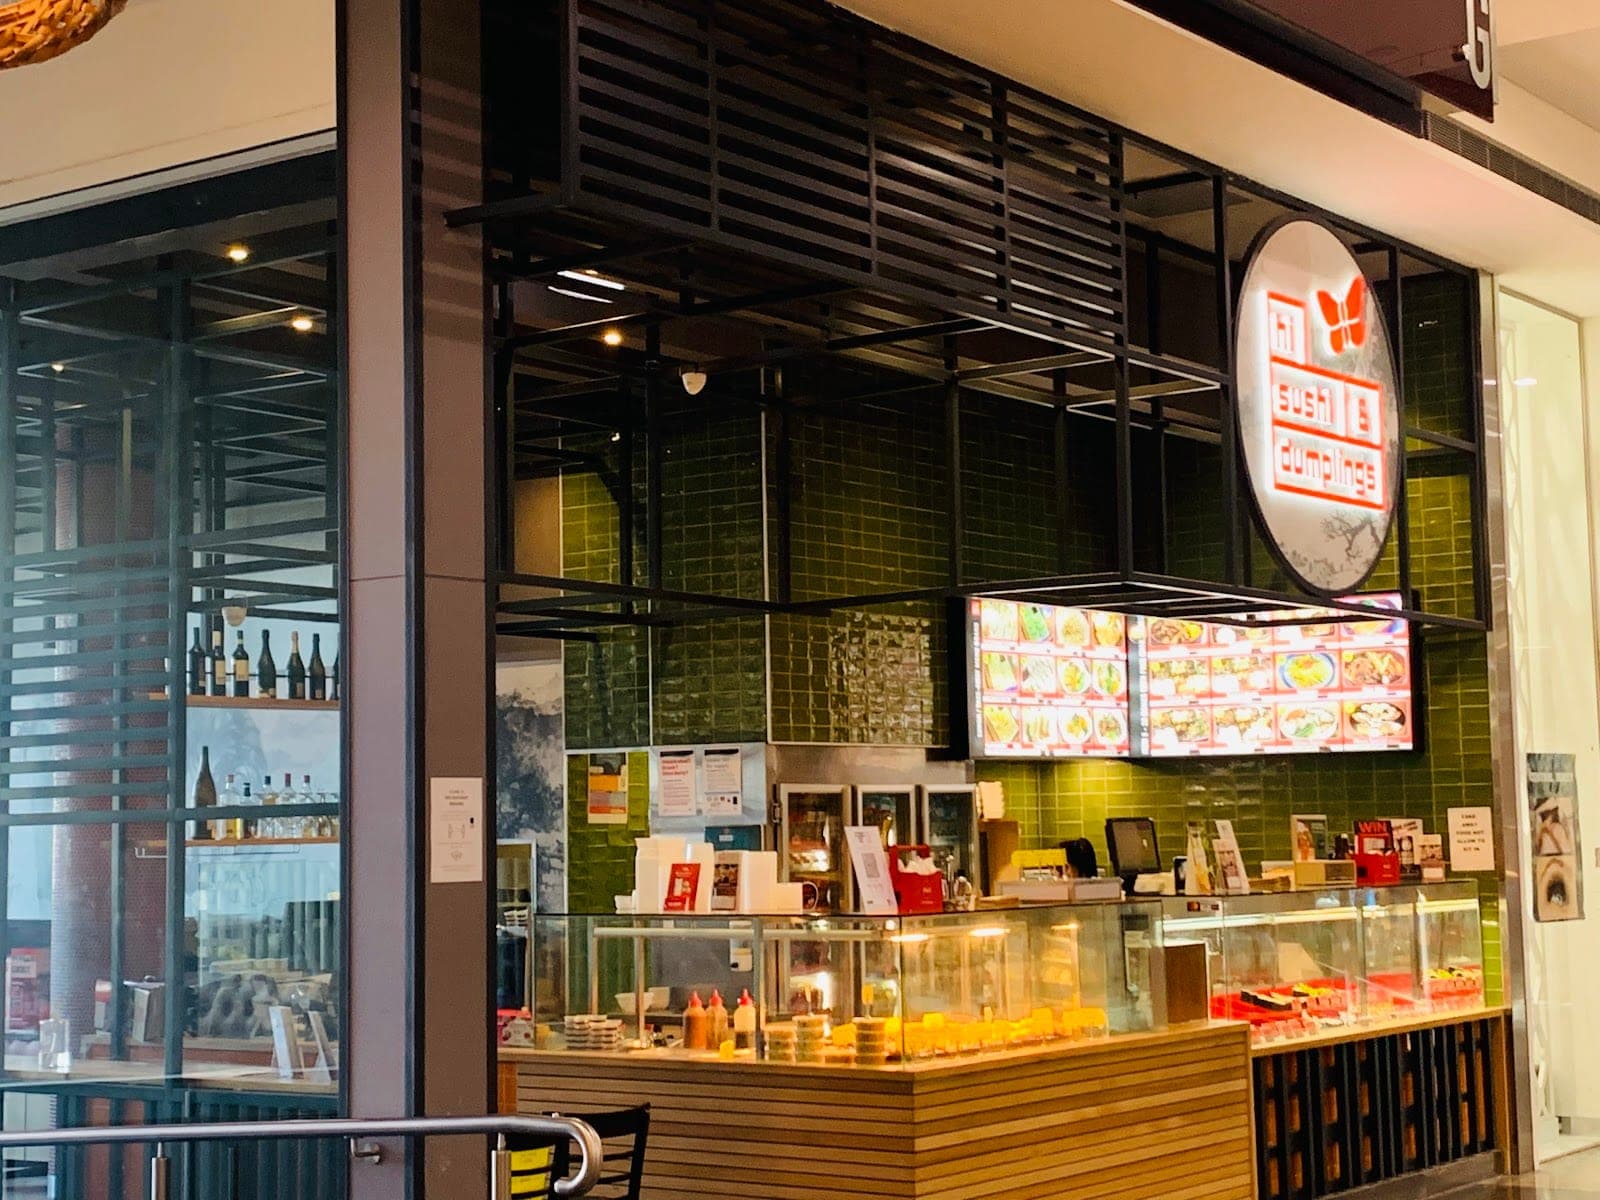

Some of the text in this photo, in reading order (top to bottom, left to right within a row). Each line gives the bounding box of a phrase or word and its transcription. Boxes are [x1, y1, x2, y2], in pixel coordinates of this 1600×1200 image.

[1270, 312, 1295, 353] hi
[1275, 383, 1335, 425] sushi
[1279, 438, 1375, 496] dumplings
[1359, 821, 1387, 833] WIN
